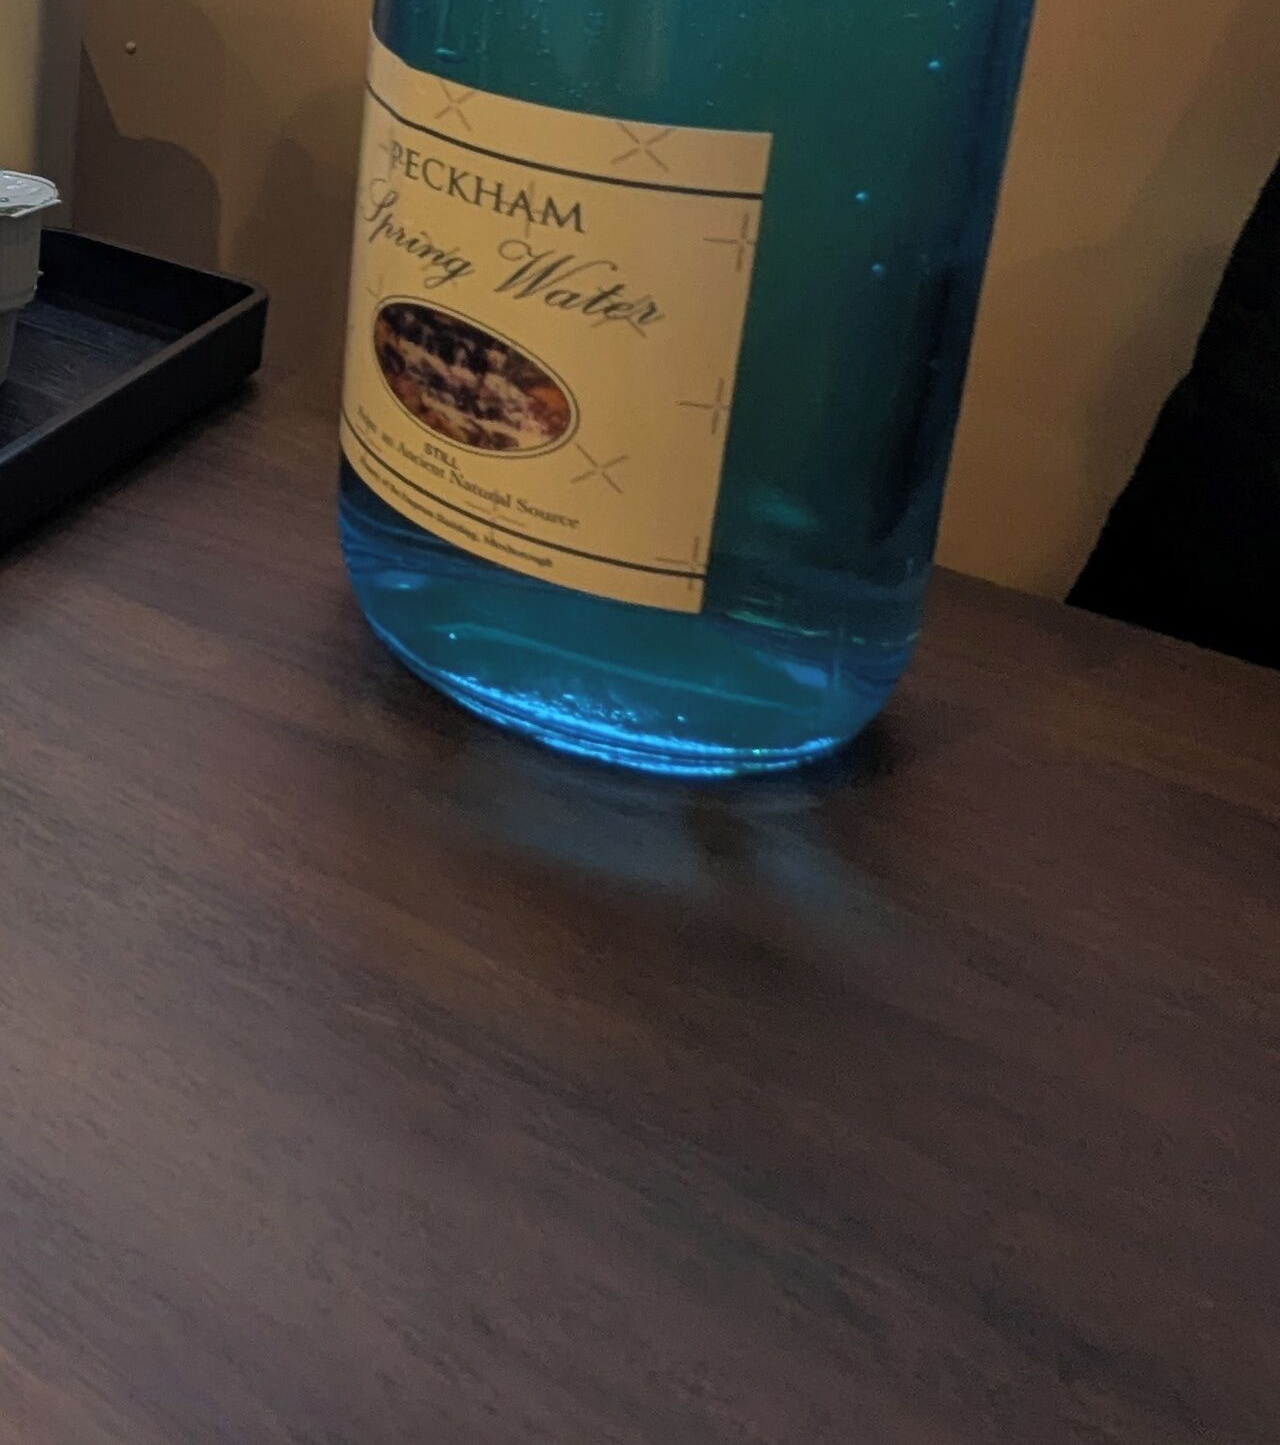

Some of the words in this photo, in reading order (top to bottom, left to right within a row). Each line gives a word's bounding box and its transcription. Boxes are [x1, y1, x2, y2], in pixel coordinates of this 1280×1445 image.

[364, 177, 474, 289] Spring
[493, 239, 663, 329] Water
[516, 498, 580, 530] Source
